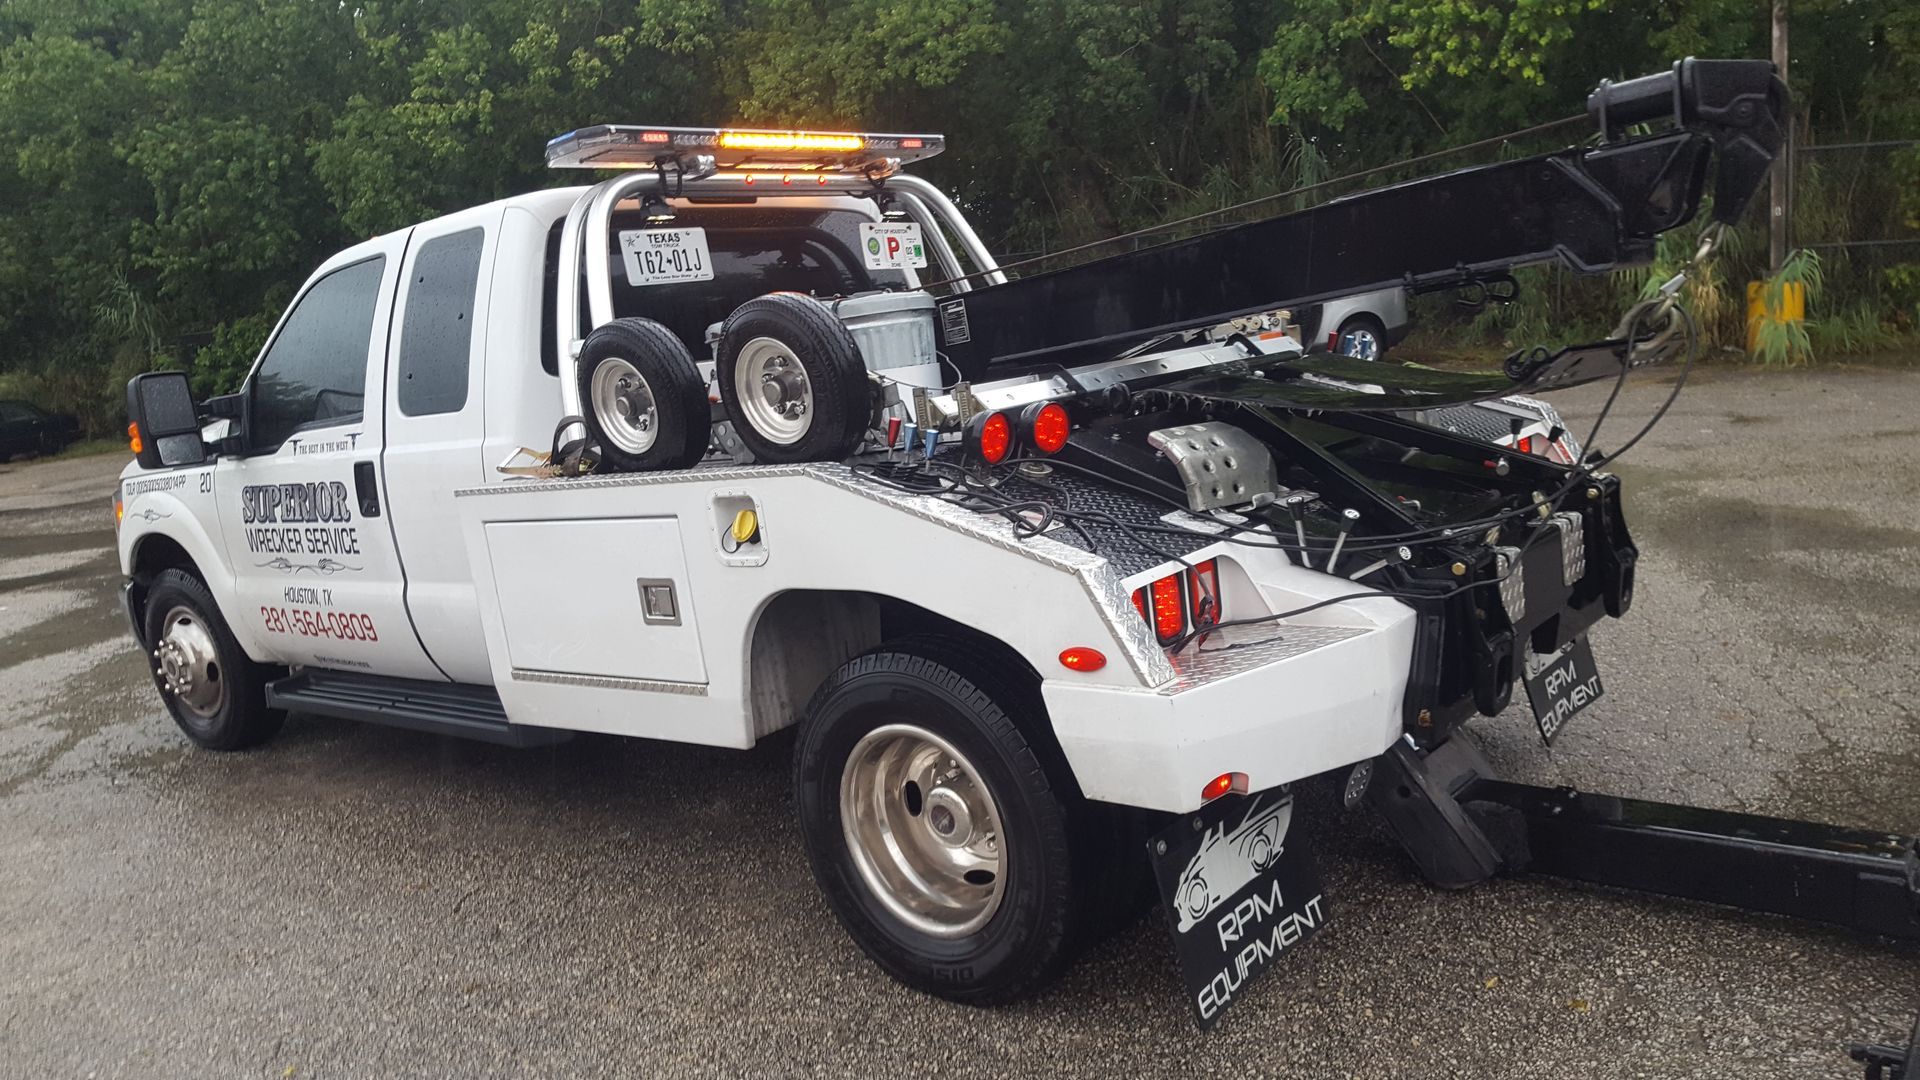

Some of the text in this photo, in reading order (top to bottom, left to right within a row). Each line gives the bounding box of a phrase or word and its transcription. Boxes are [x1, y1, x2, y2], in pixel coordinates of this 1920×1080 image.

[647, 232, 681, 244] TEXAS
[886, 236, 900, 259] P
[299, 445, 308, 455] THE
[308, 444, 319, 454] BEST
[325, 442, 335, 452] THE
[335, 441, 349, 451] WEST
[200, 472, 212, 493] 20
[242, 481, 352, 524] SUPERIOR
[245, 527, 361, 555] WRECKER SERVICE
[284, 586, 333, 608] HOUSTON, TX
[260, 606, 379, 642] 281-564-0809
[1544, 659, 1577, 700] RPM
[1541, 675, 1600, 738] EQUIPMENT
[1217, 879, 1284, 952] RPM
[1197, 894, 1324, 1020] EQUIPMENT
